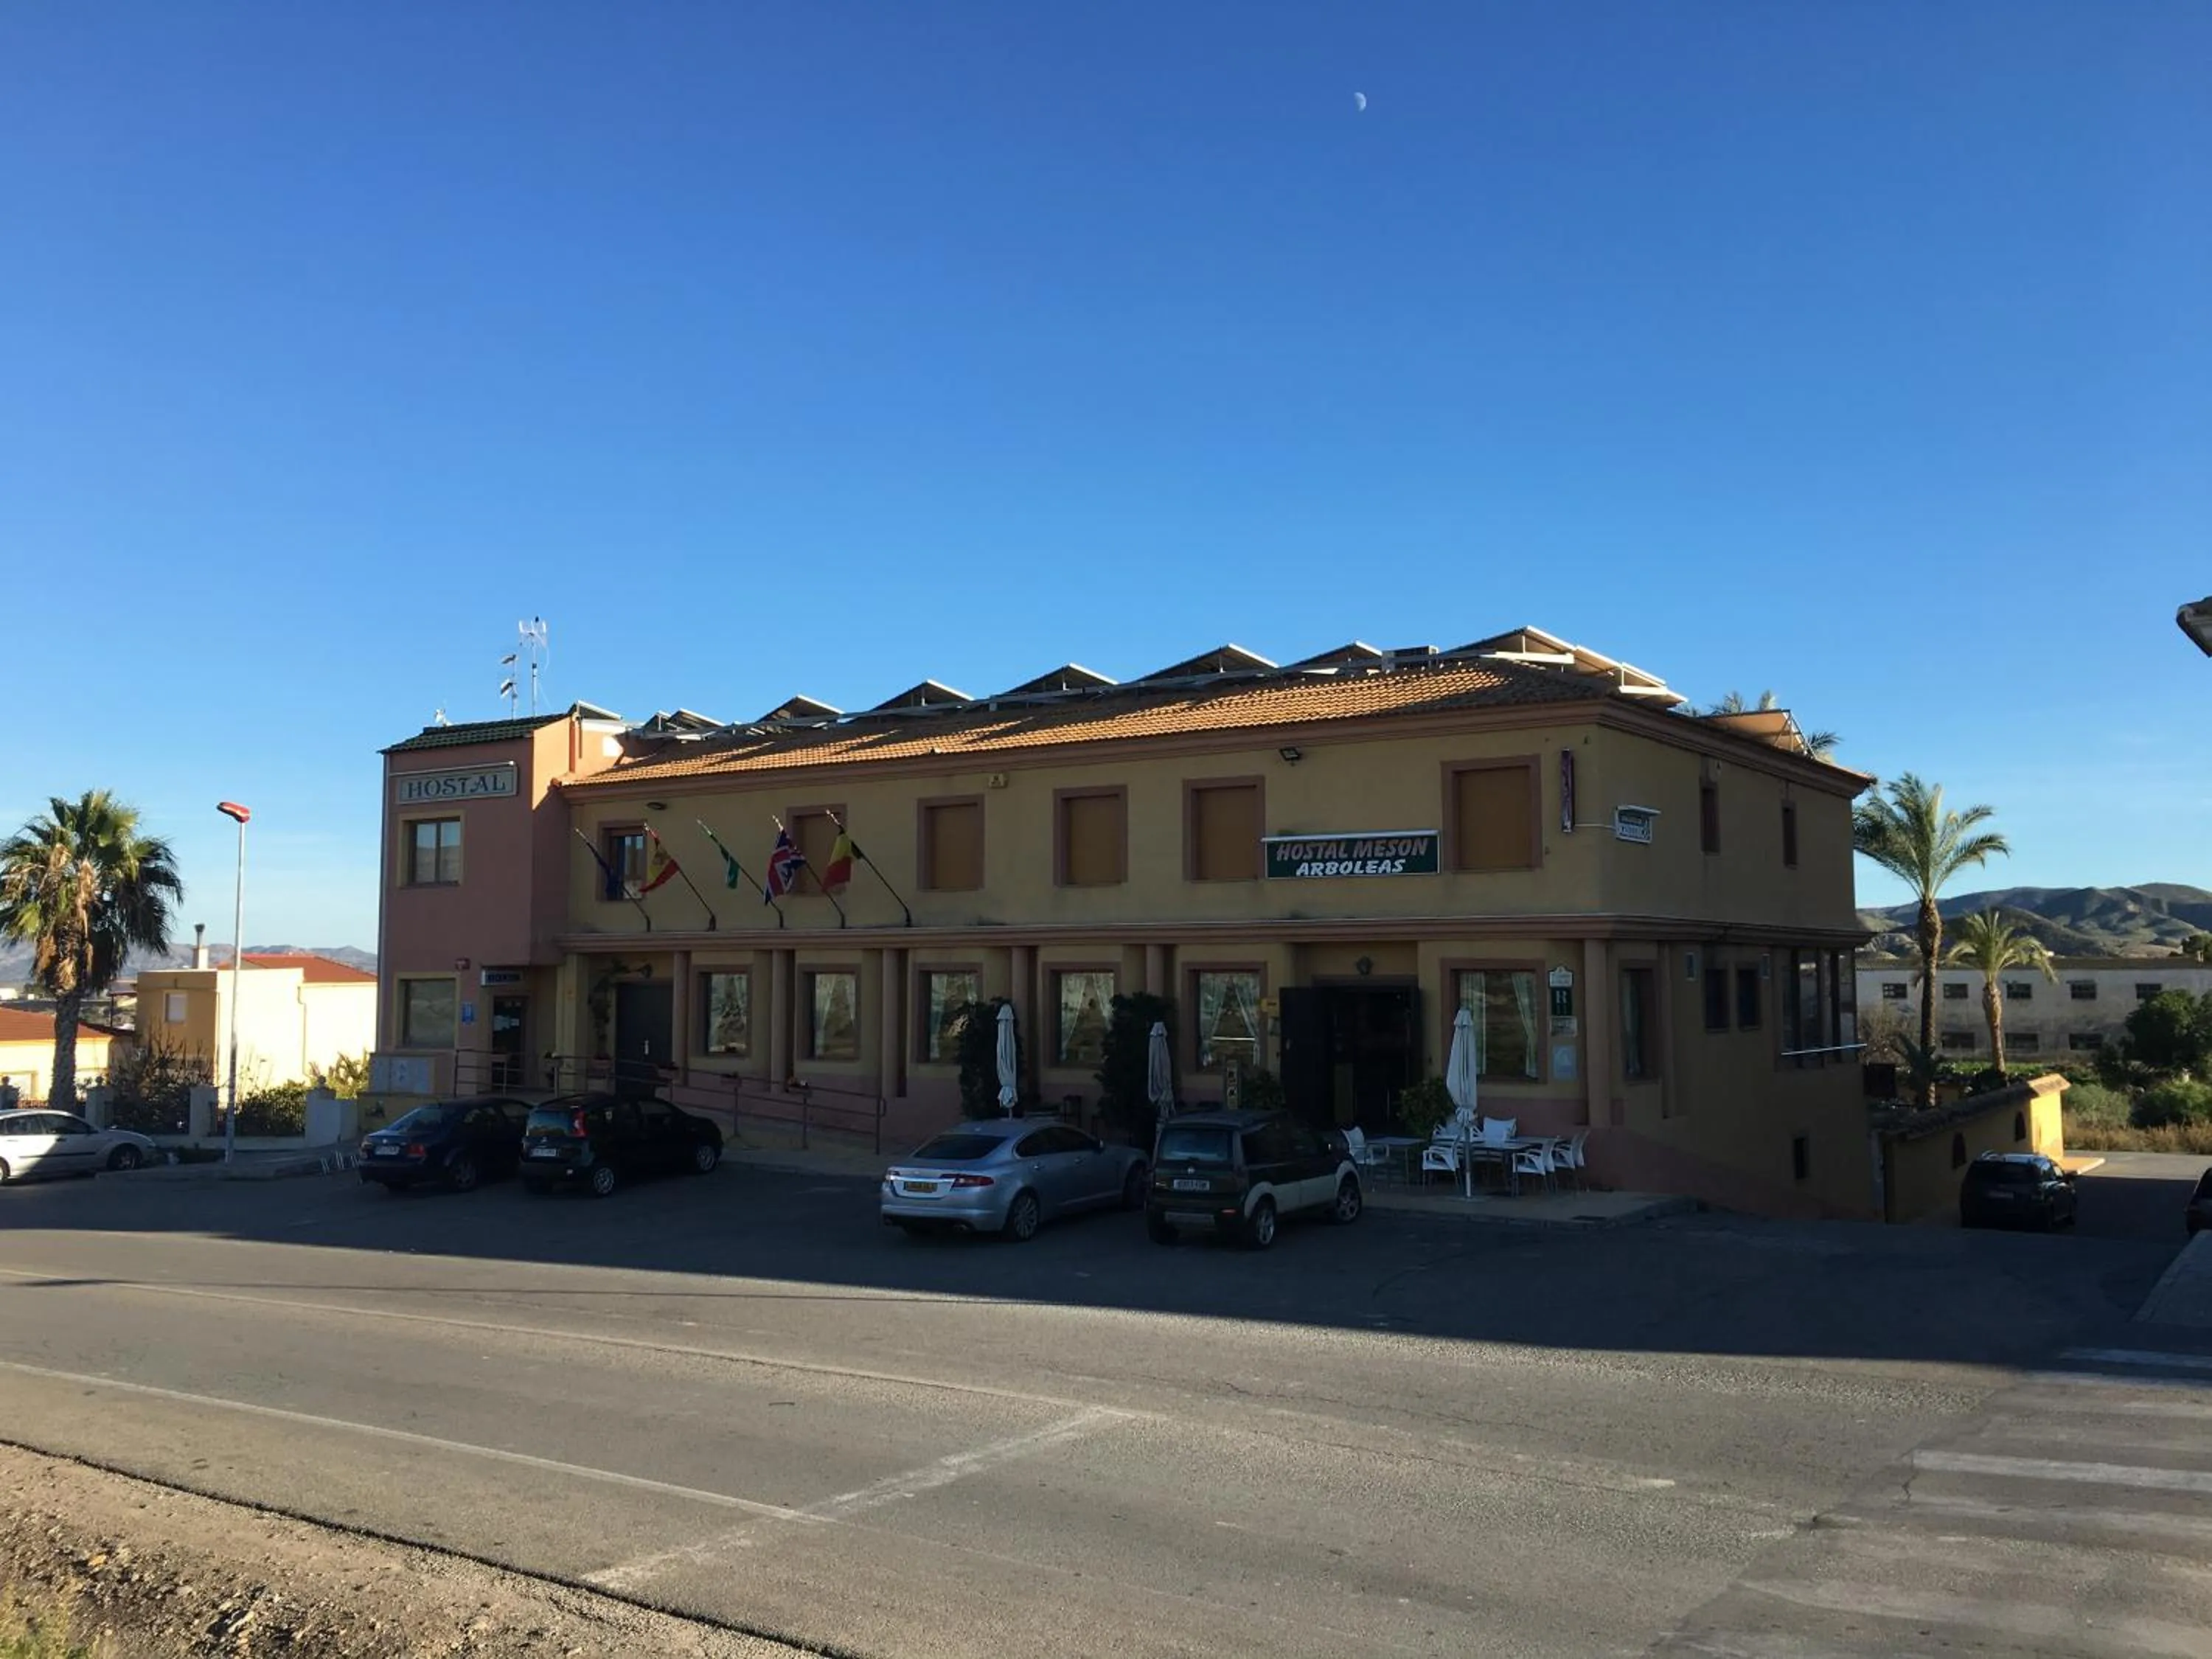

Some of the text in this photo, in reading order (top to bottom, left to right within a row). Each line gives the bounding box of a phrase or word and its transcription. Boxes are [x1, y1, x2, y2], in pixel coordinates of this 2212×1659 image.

[408, 774, 506, 799] HOSTAL
[1276, 841, 1348, 861] HOSTAL
[1295, 859, 1406, 877] ARBOLEAS
